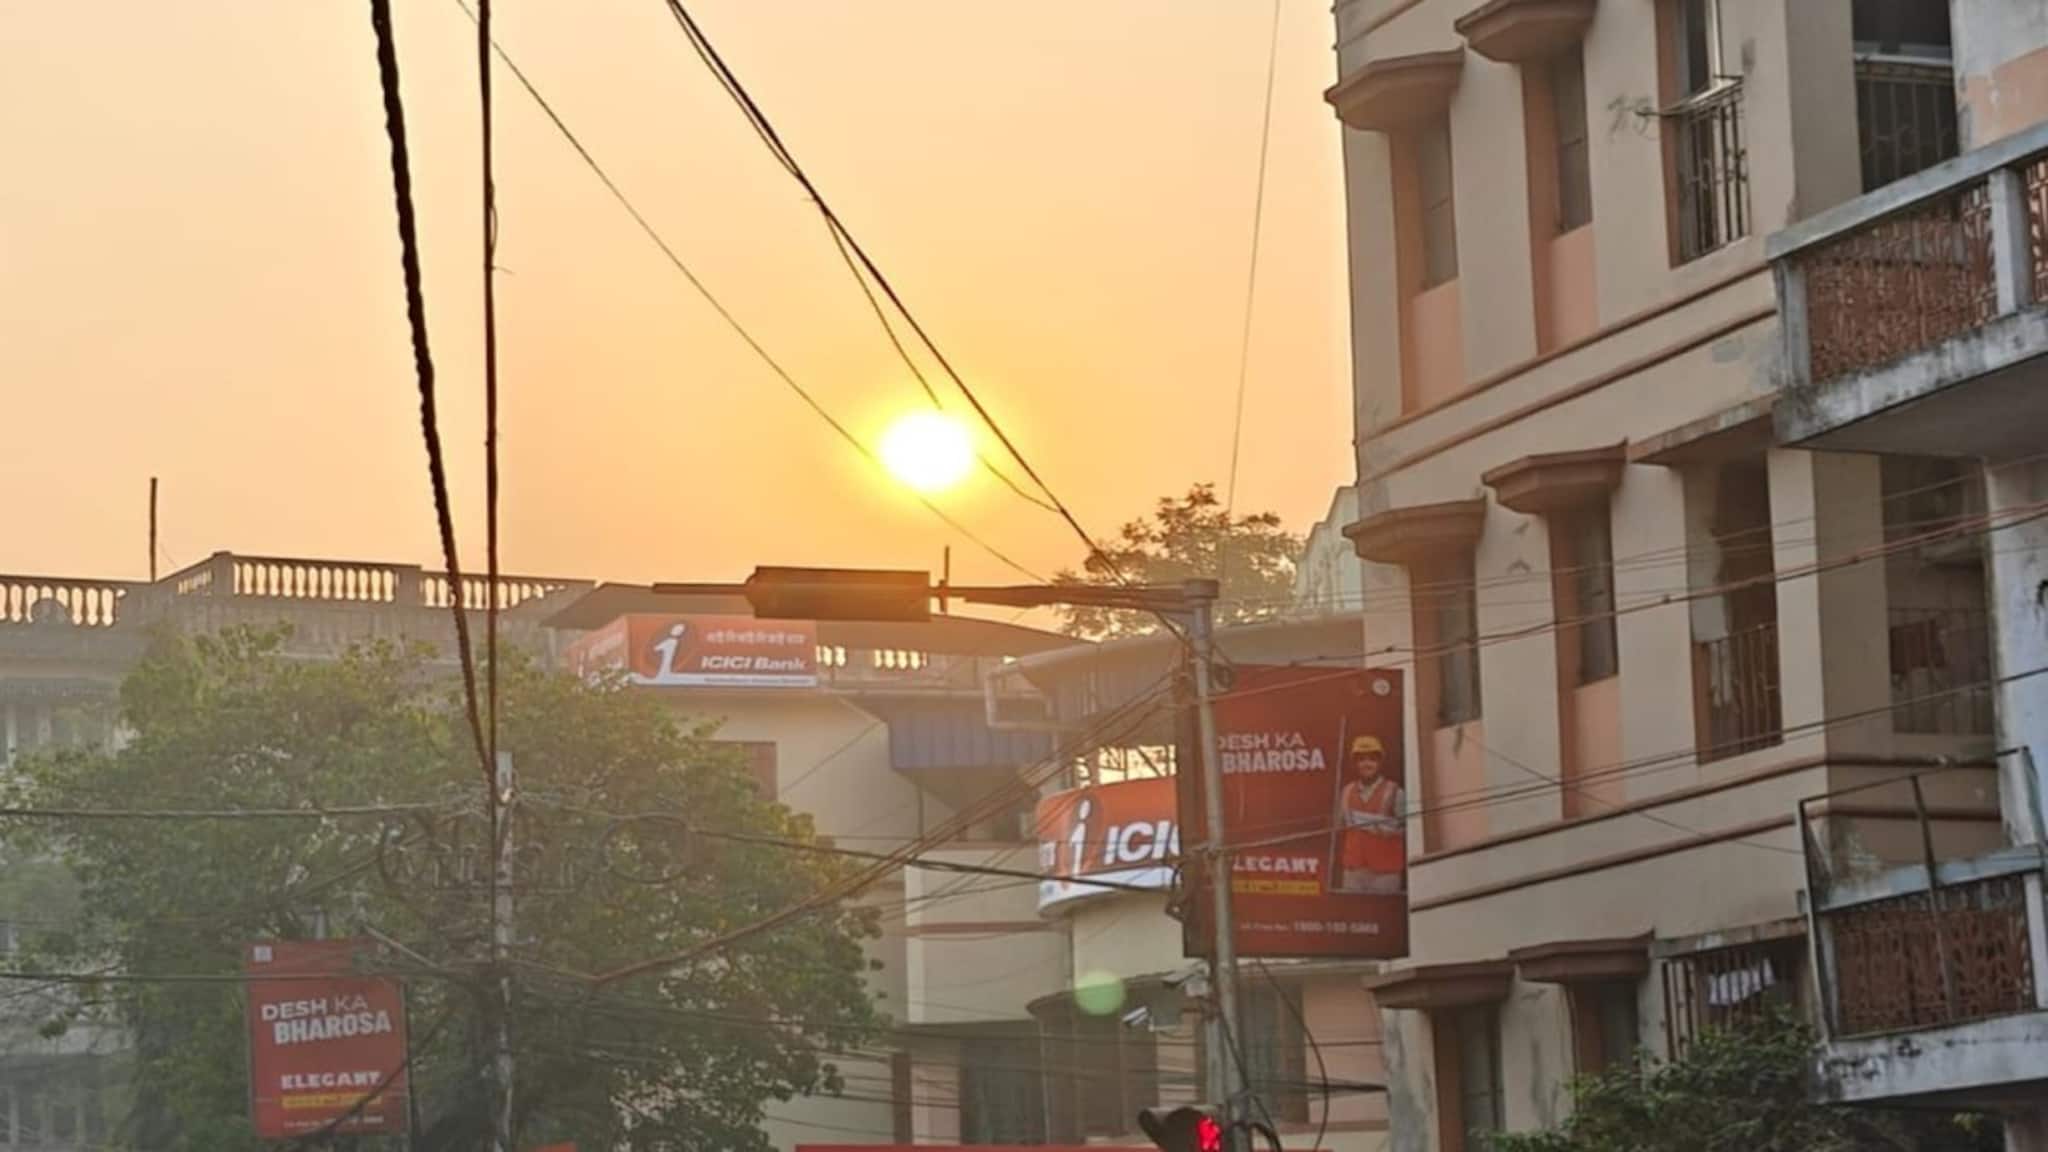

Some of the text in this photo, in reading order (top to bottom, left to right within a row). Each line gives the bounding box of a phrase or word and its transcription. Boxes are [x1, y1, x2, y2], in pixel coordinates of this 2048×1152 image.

[702, 656, 805, 670] ICICI Bank
[1217, 731, 1305, 750] DESH KA
[1222, 747, 1325, 774] BHAROSA
[1103, 820, 1181, 866] ICI
[1232, 857, 1319, 873] LEGANT
[260, 994, 368, 1021] DESH KA
[274, 1010, 392, 1045] BHAROSA
[280, 1070, 381, 1090] ELEGANT
